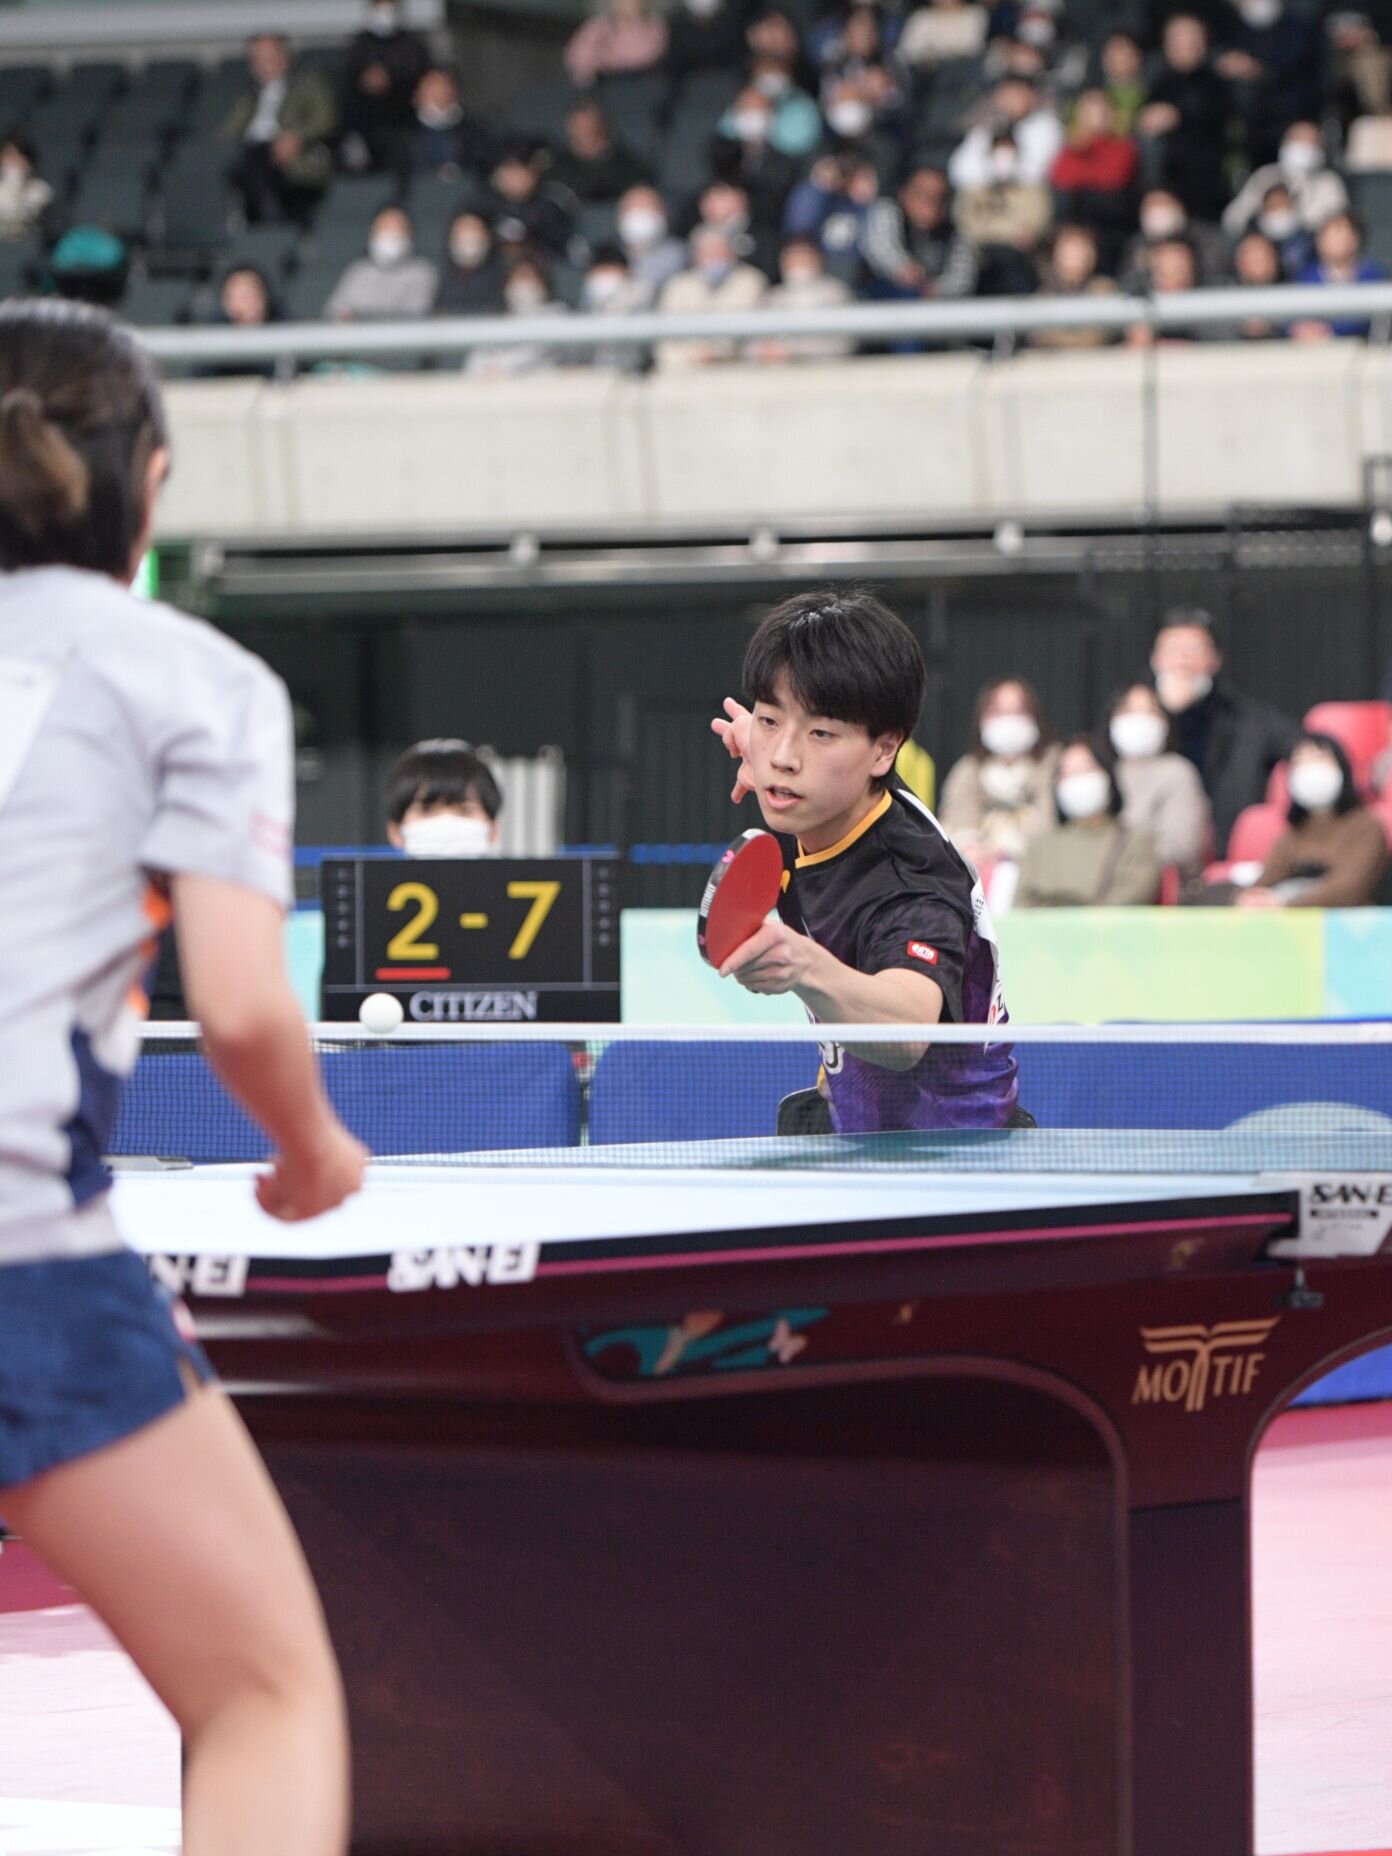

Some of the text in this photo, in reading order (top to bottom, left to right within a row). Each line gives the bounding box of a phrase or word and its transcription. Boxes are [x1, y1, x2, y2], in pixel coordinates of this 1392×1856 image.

[387, 881, 440, 961] 2
[506, 880, 562, 960] 7
[408, 990, 539, 1022] CITIZEN
